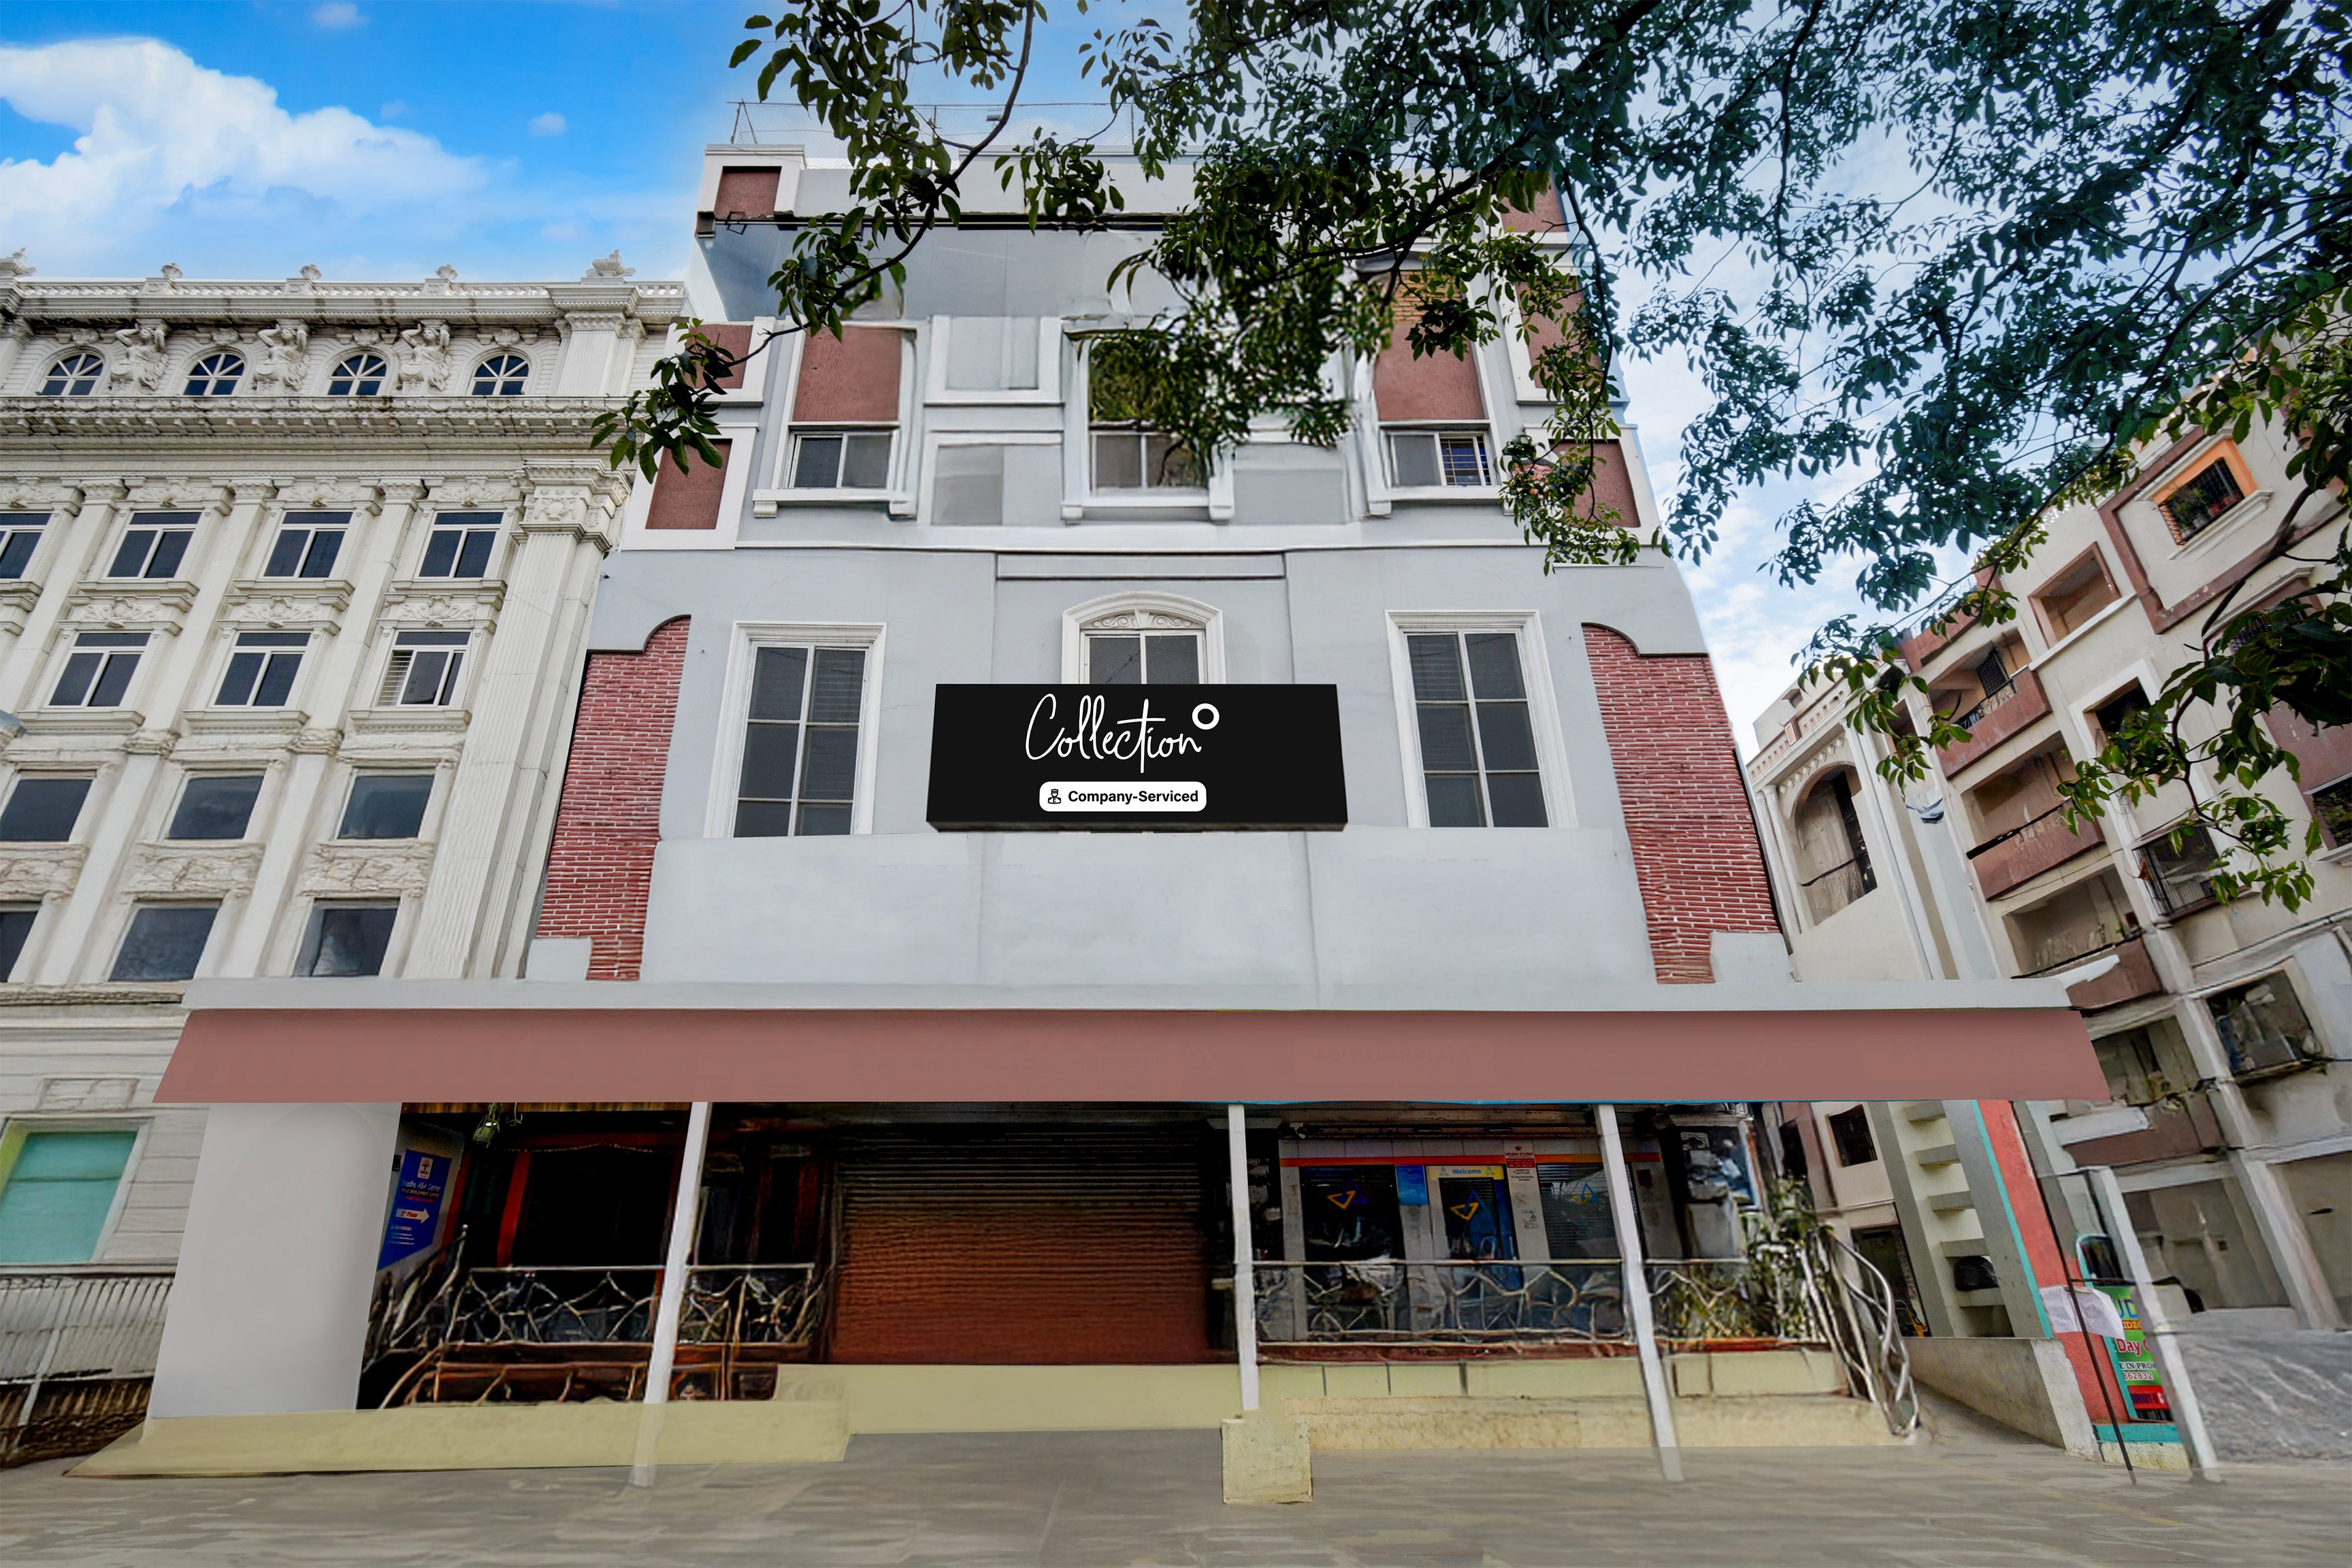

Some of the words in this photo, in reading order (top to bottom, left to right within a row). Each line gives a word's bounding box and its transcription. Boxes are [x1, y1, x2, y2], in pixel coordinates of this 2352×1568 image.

[1024, 693, 1202, 774] Collection
[1067, 789, 1199, 804] Company-Serviced
[2116, 1338, 2141, 1356] Day
